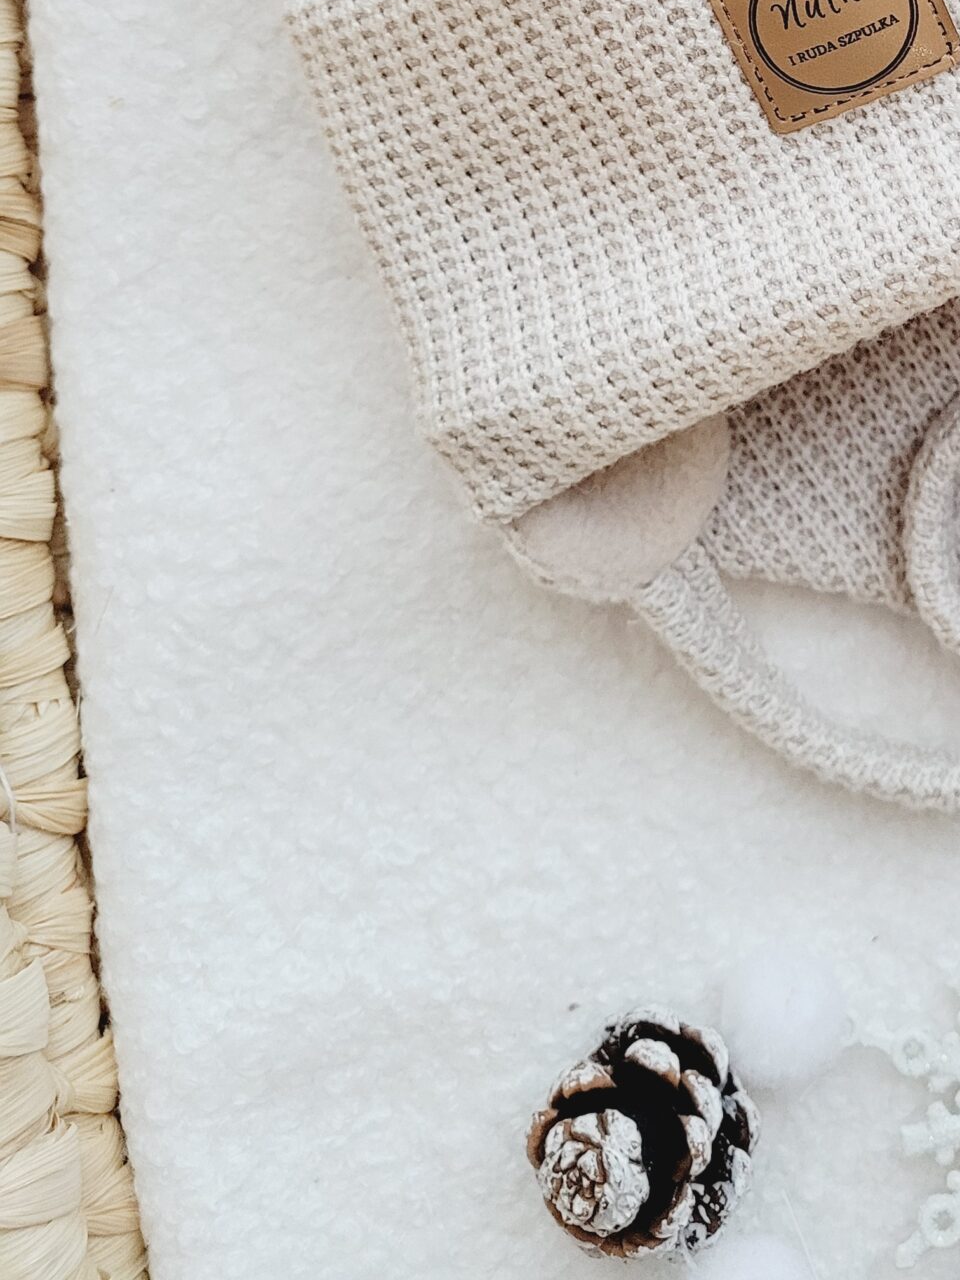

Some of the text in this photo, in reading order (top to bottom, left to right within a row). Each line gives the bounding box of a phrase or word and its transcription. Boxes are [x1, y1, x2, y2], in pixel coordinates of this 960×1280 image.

[788, 14, 900, 66] I RUDA SZPULKA
